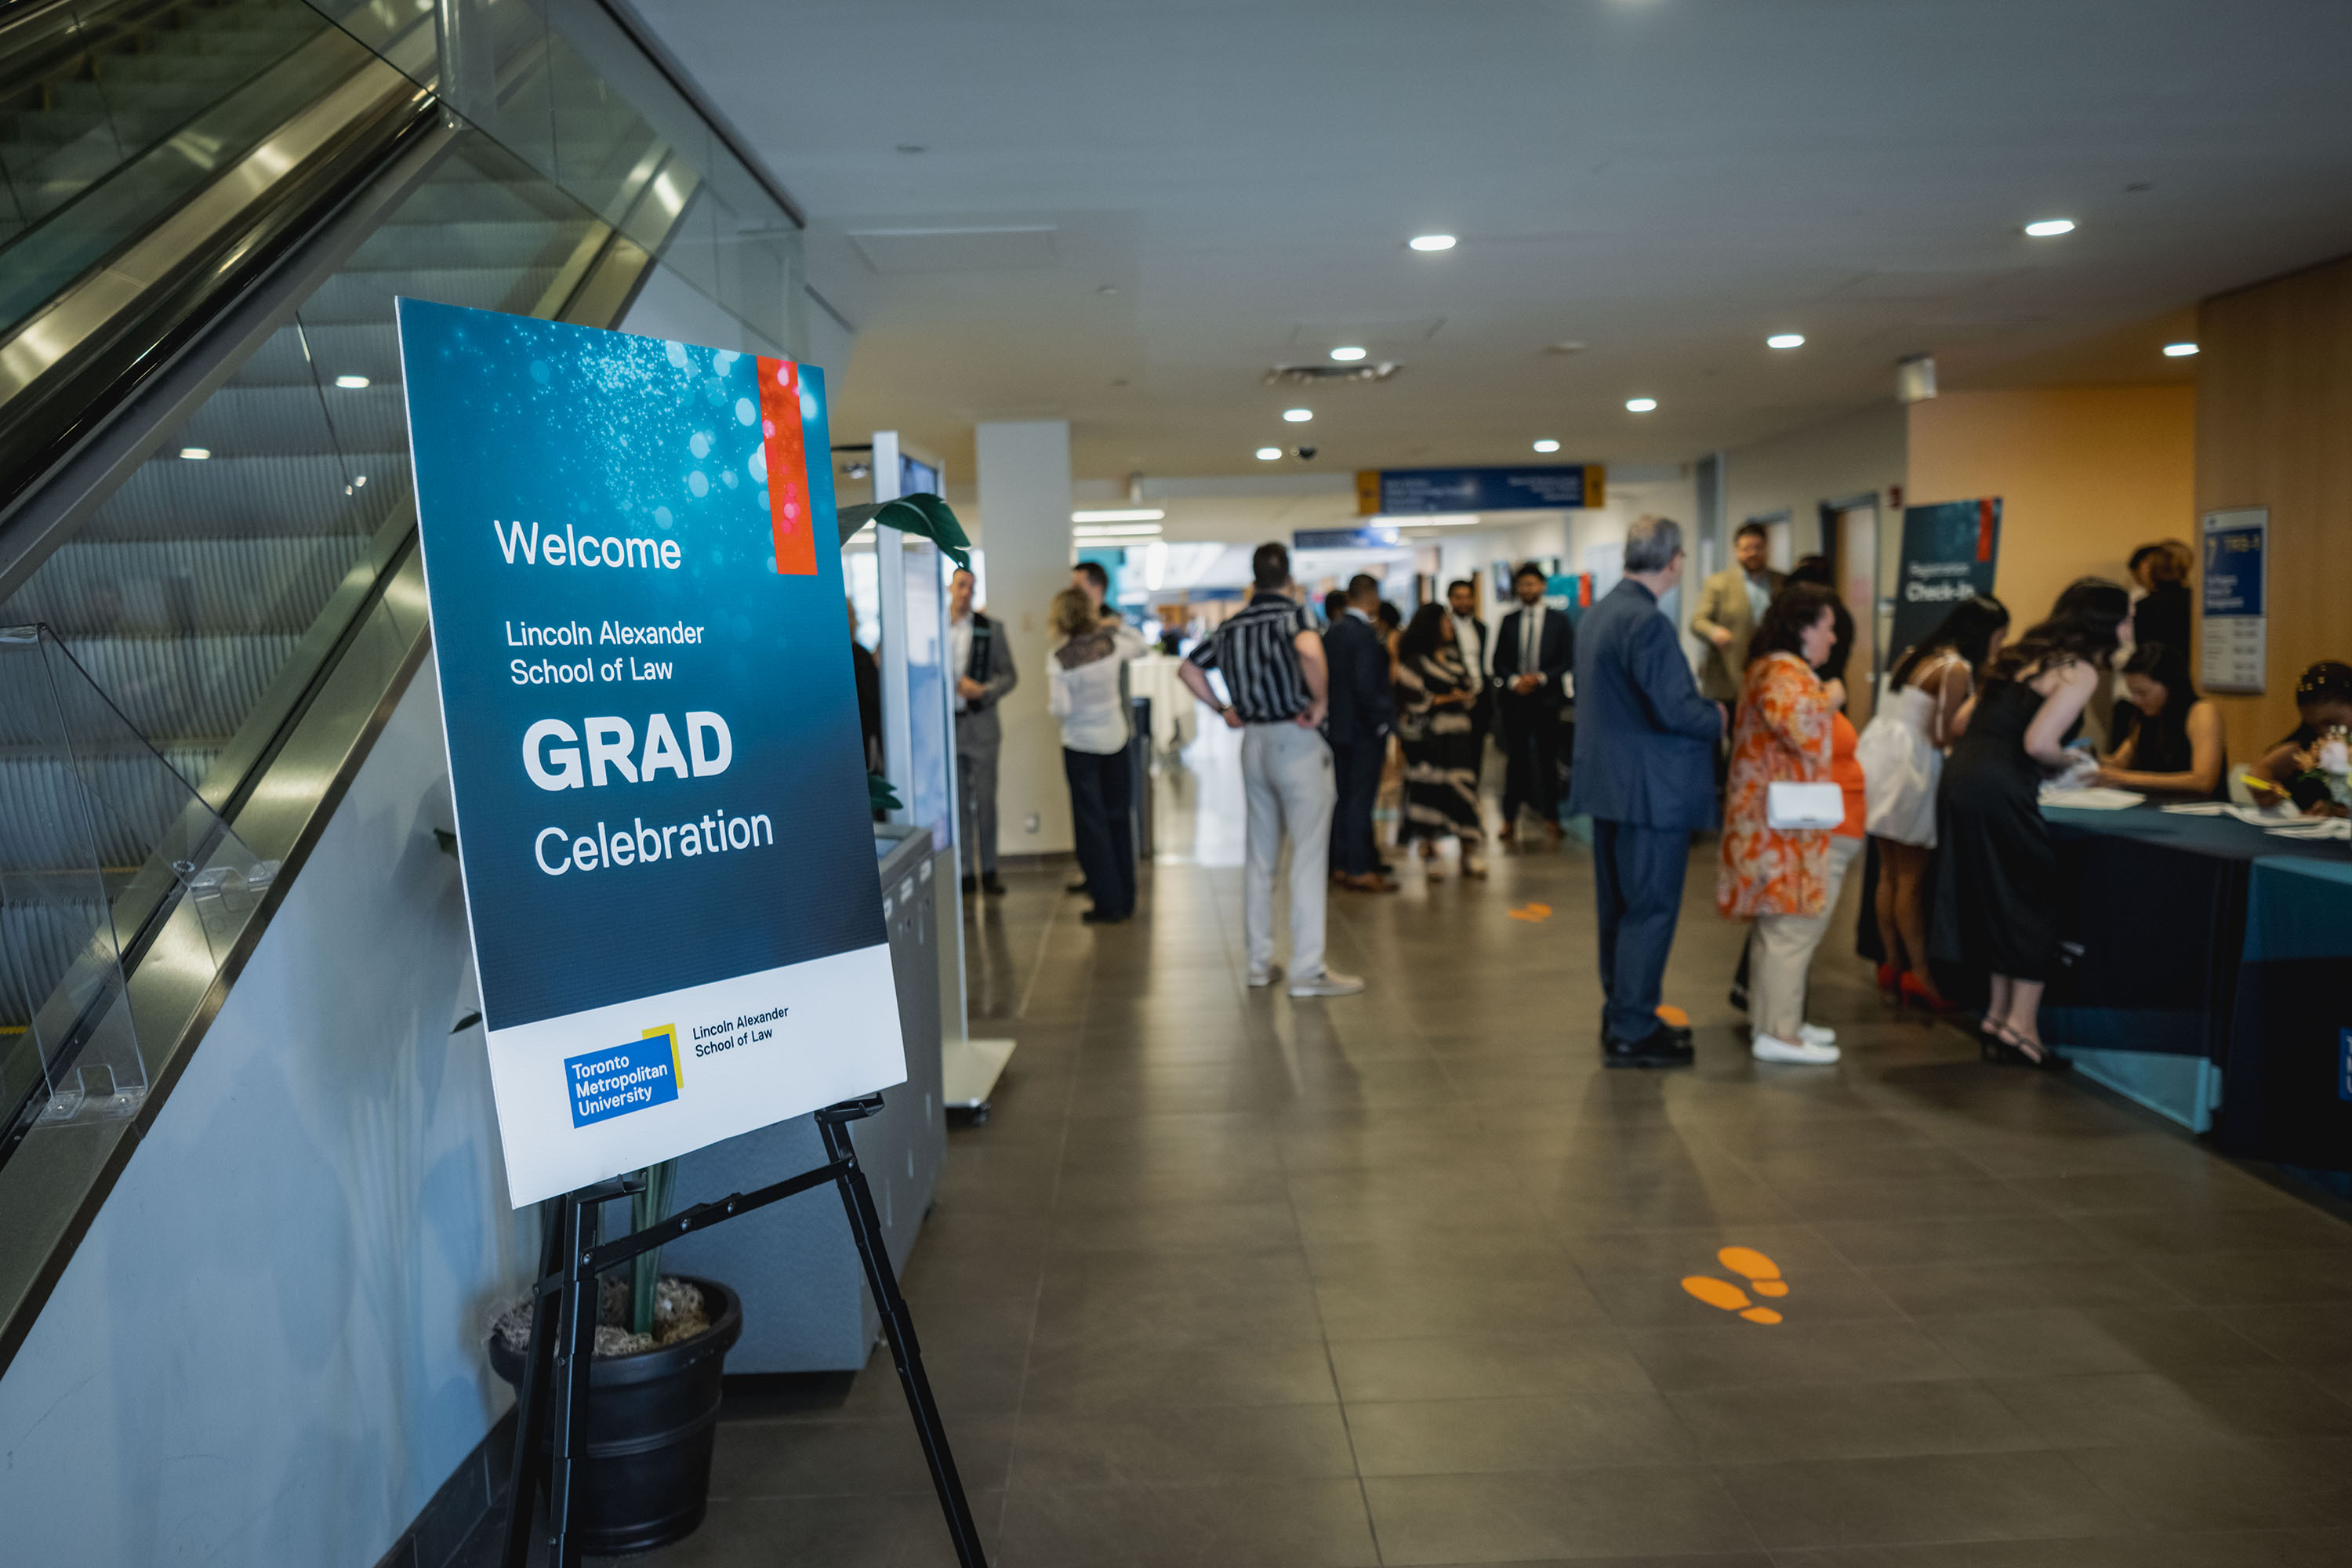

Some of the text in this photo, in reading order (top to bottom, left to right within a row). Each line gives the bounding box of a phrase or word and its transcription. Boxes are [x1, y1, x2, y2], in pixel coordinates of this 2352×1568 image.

[494, 520, 681, 570] Welcome
[506, 619, 705, 647] Lincoln Alexander
[510, 656, 673, 686] School of Law
[523, 710, 732, 792] GRAD
[535, 809, 774, 877] Celebration
[692, 1007, 789, 1041] Lincoln Alexander
[695, 1029, 773, 1058] School of Law
[572, 1054, 630, 1080] Toronto
[575, 1064, 668, 1099] Metropolitan
[578, 1086, 652, 1117] University
